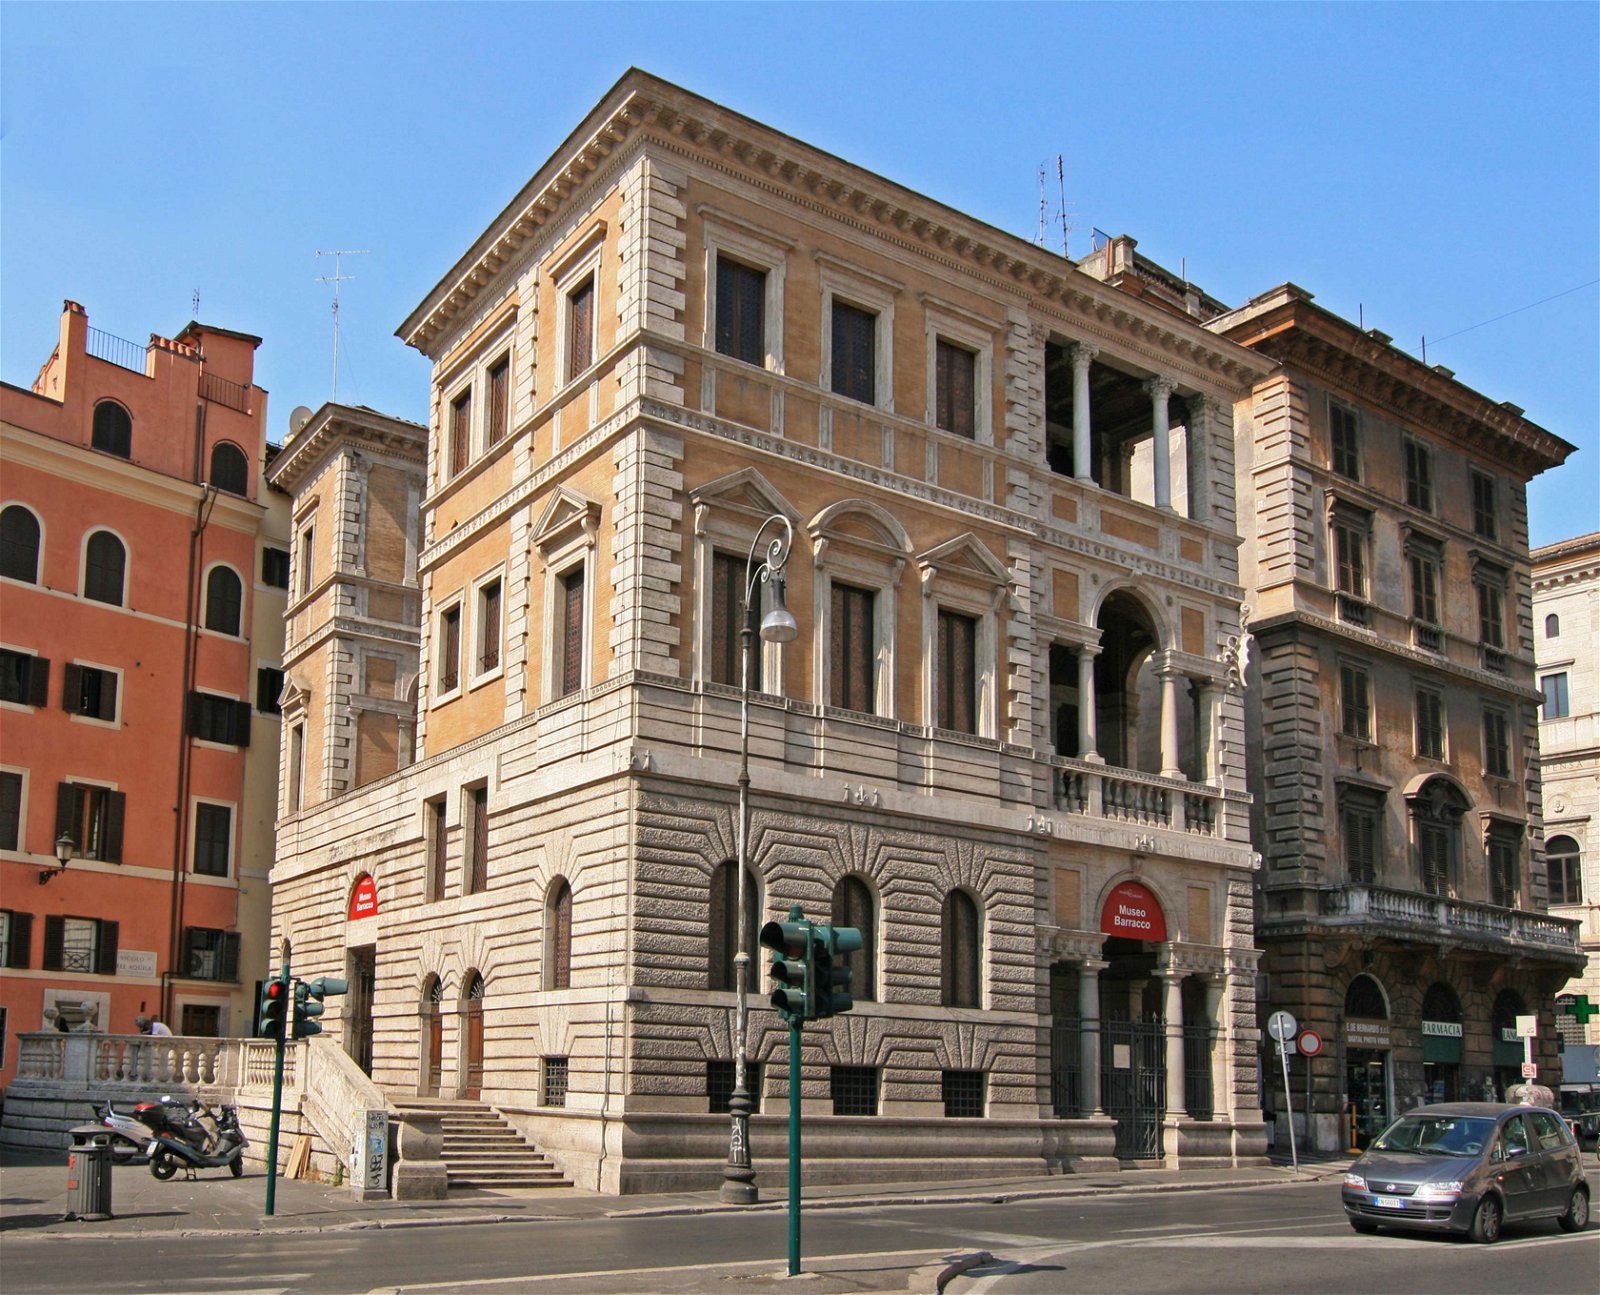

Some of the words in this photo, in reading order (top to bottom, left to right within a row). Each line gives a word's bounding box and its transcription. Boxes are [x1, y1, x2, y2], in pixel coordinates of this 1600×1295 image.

[1119, 904, 1146, 917] Museo
[1114, 915, 1151, 930] Barracco
[1423, 1023, 1461, 1036] FARMACIA
